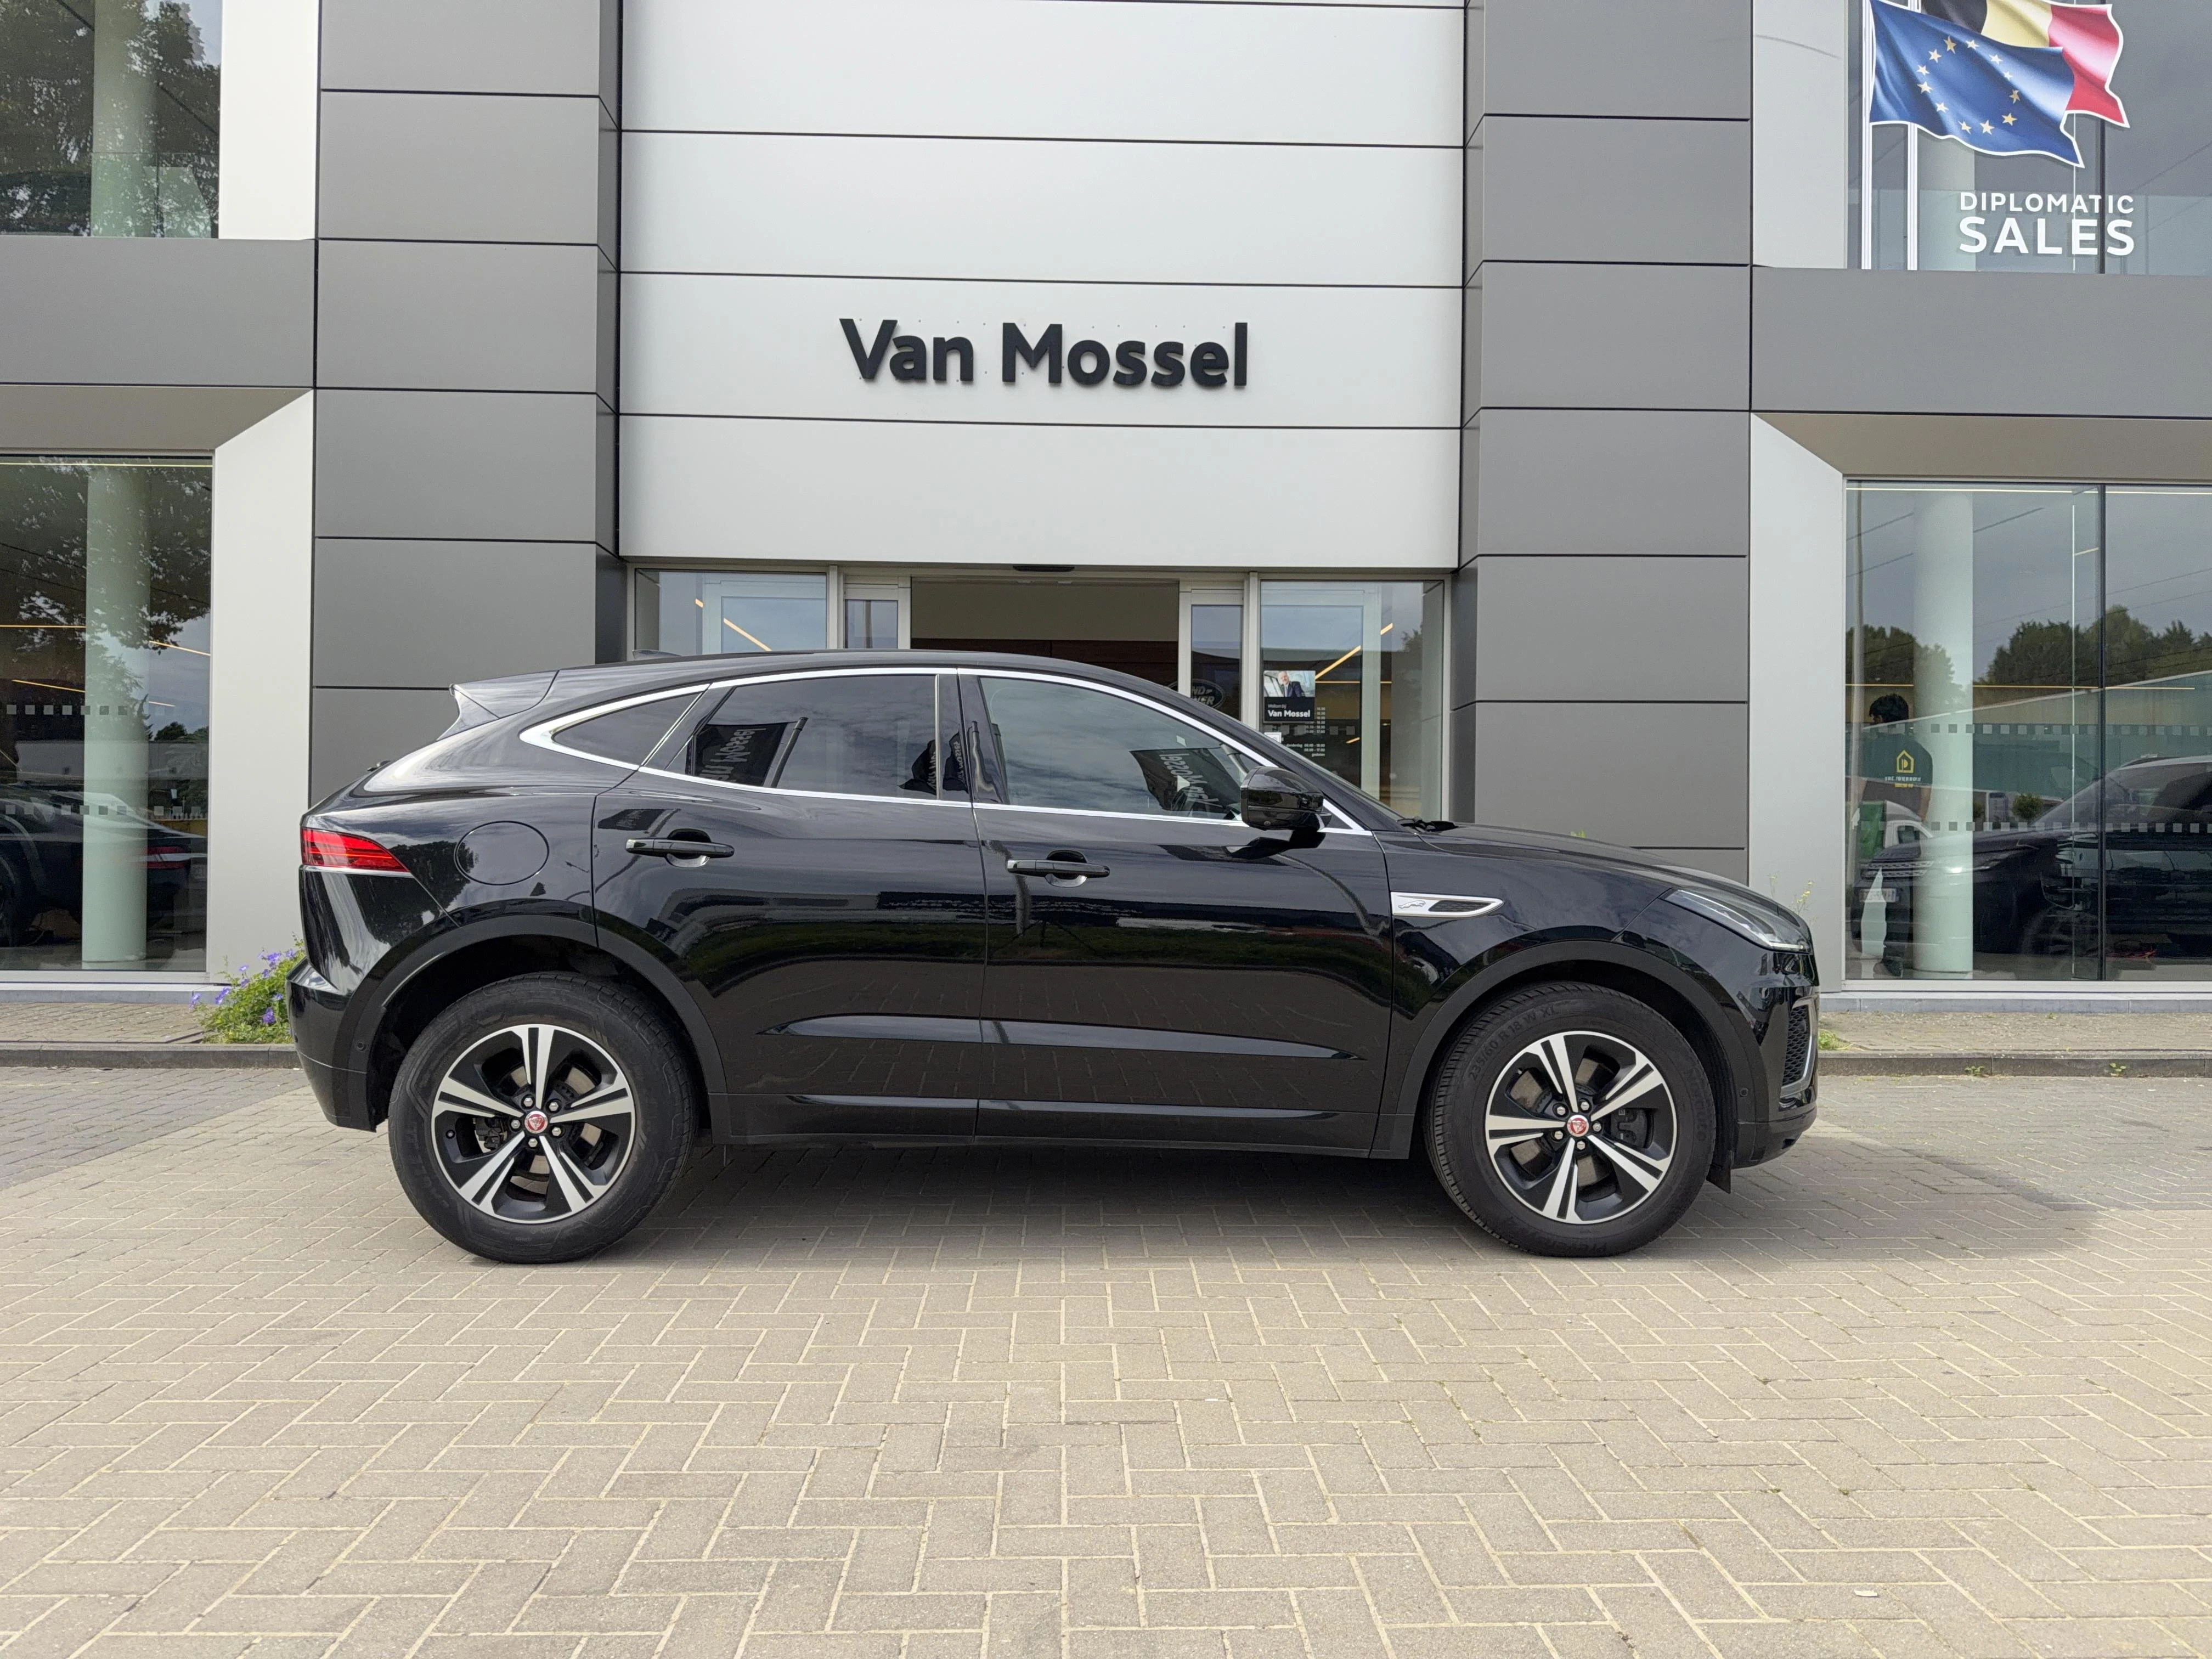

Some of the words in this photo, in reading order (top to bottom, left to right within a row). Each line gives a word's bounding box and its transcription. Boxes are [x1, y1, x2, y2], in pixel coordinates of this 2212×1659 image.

[1960, 192, 2134, 214] DIPLOMATIC
[1959, 216, 2134, 256] SALES
[839, 318, 974, 382] Van
[1002, 322, 1248, 387] Mossel
[1508, 1021, 1523, 1035] 18
